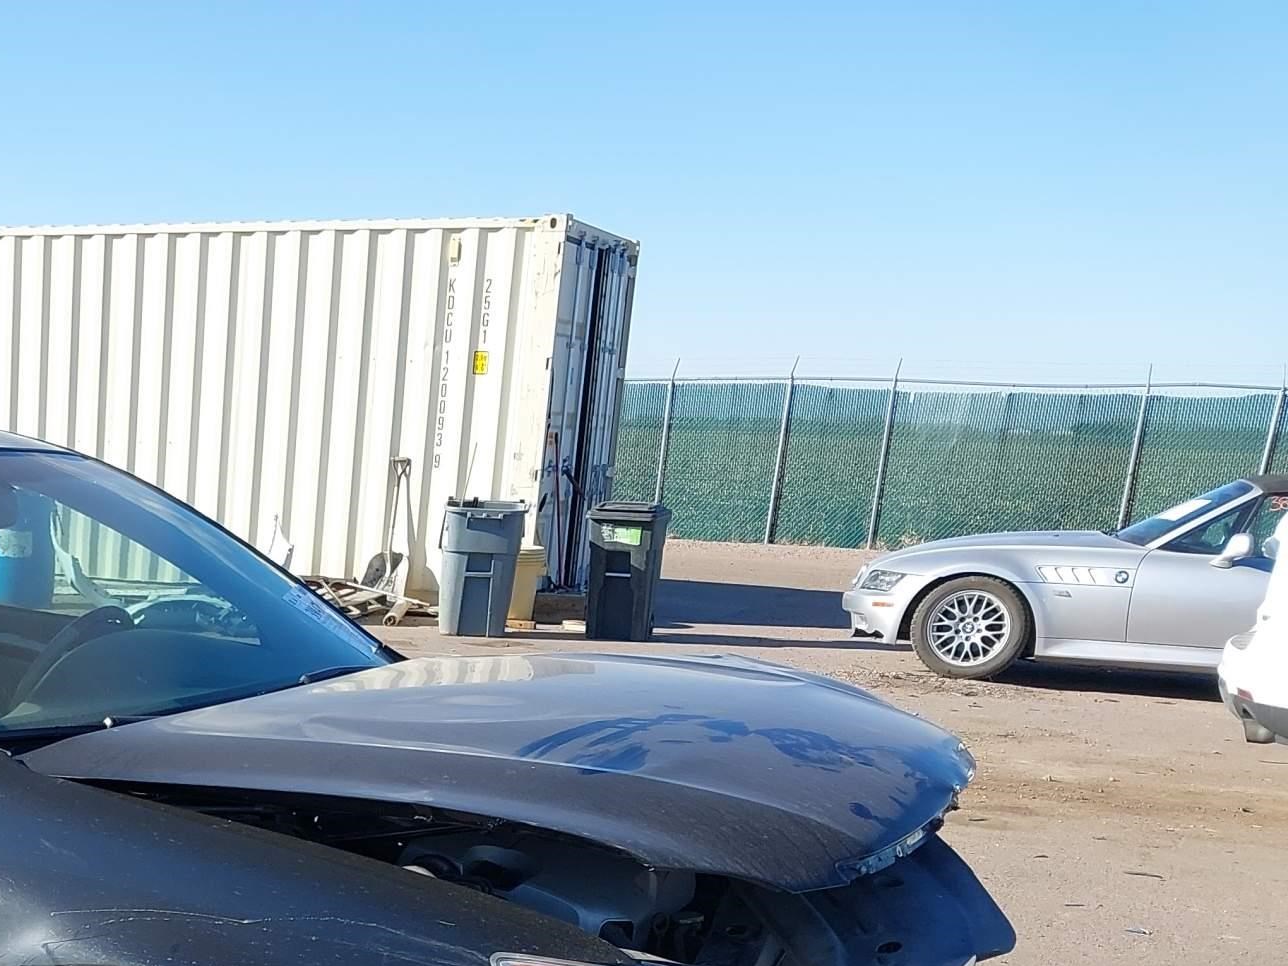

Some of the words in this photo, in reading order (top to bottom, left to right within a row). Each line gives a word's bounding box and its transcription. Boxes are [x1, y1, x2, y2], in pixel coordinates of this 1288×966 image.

[444, 278, 456, 343] KDCU
[481, 278, 493, 345] 25G1
[435, 349, 450, 447] 120093
[433, 453, 441, 469] 9
